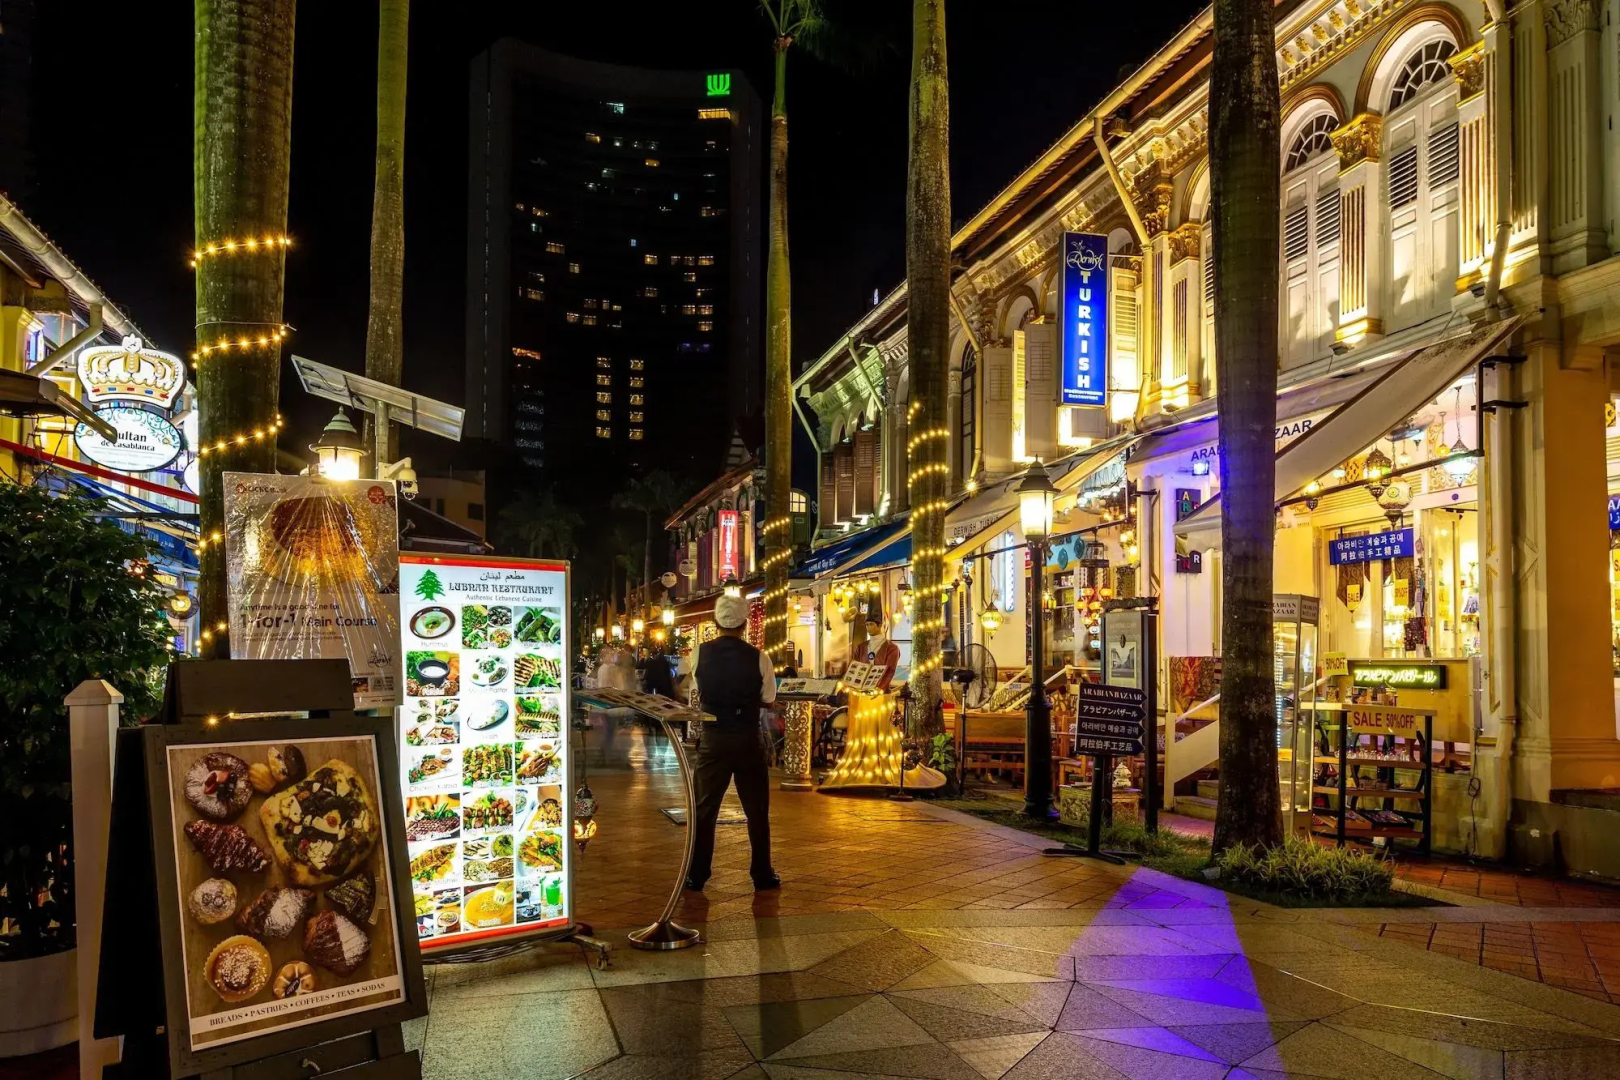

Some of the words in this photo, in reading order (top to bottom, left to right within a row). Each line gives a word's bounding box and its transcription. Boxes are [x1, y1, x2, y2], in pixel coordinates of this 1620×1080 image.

[1077, 270, 1091, 388] TURKISH
[118, 431, 147, 442] ultan
[449, 582, 489, 592] LUBNAN
[491, 584, 554, 595] RESTAURANT
[495, 594, 520, 602] Lebanese
[1347, 592, 1359, 603] SALE
[336, 616, 378, 627] Course
[1326, 656, 1346, 670] 50%OFF
[1082, 687, 1114, 697] ARABIAN
[1114, 690, 1143, 701] BAZAAR
[1353, 711, 1382, 727] SALE
[1386, 713, 1415, 729] 50%OFF
[209, 1012, 243, 1027] BREADS
[250, 1002, 289, 1017] PASTRIES
[294, 994, 330, 1007] COFFEES
[336, 988, 355, 998] TEAS
[361, 982, 385, 993] SODAS
